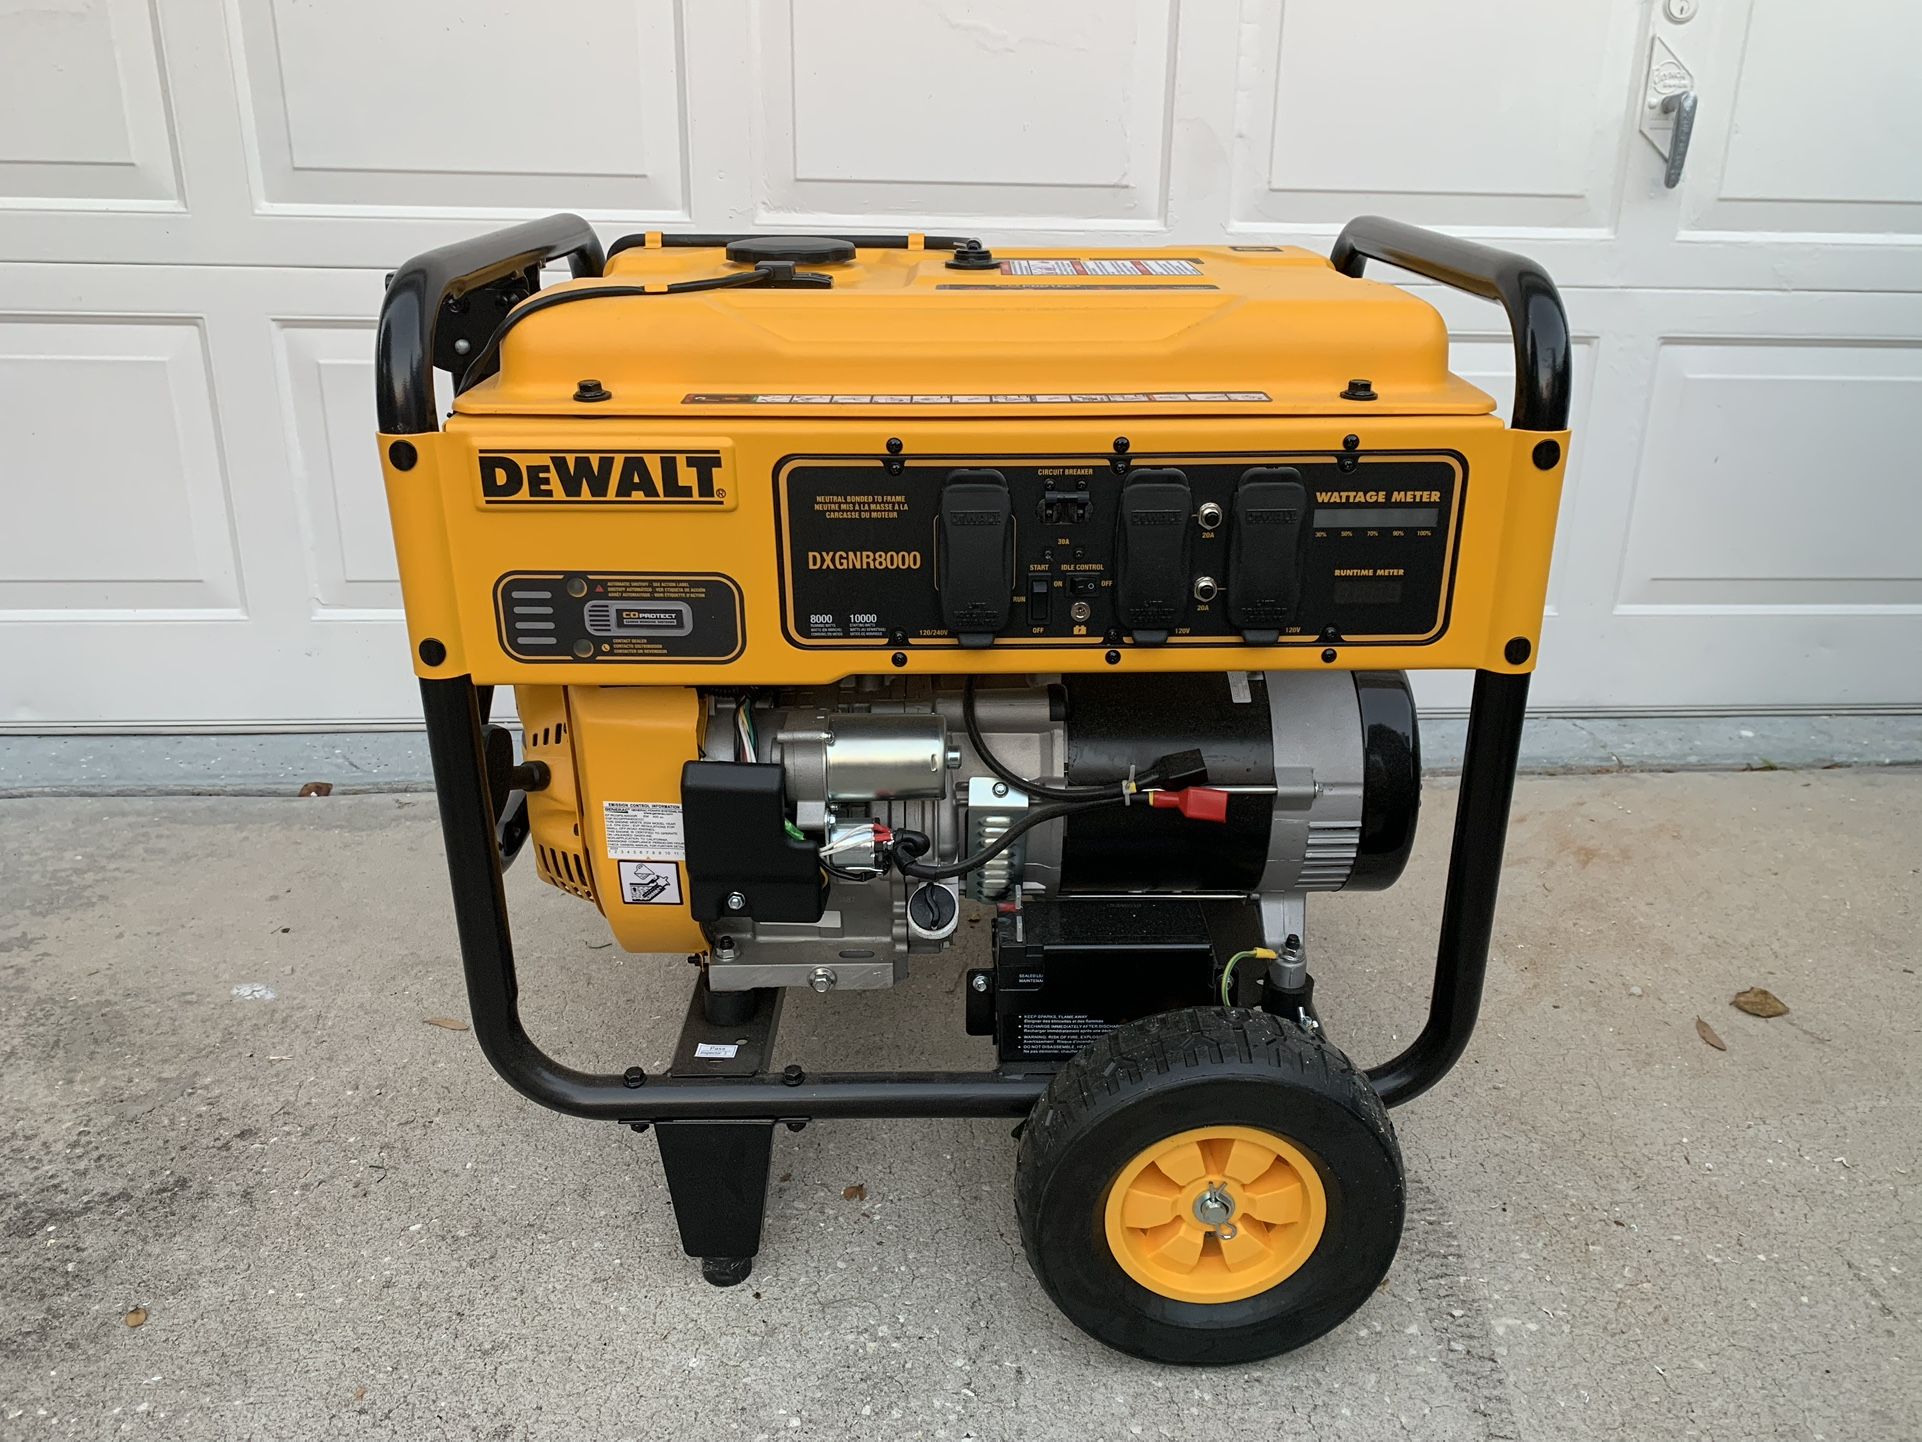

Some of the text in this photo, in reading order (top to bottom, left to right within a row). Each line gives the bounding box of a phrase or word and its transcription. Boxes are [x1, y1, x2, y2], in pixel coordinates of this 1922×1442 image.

[1038, 468, 1094, 476] CIRCUIT BREAKER
[478, 456, 722, 498] DEWALT
[816, 495, 906, 503] NEUTRAL BONDED TO FRAME
[1315, 490, 1441, 503] WATTAGE METER
[814, 503, 840, 511] NEUTRE
[840, 503, 853, 511] MIS
[860, 503, 870, 511] LA
[870, 503, 894, 511] MASSE
[900, 503, 909, 511] LA
[825, 511, 898, 519] CARCASSE DU MOTEUR
[1202, 531, 1215, 539] 20A
[807, 550, 921, 570] DXGNR8000
[1334, 569, 1374, 577] RUNTIME
[622, 611, 639, 619] CO
[809, 614, 833, 624] 8000
[849, 613, 878, 623] 10000
[919, 629, 949, 637] 120/240V
[1285, 626, 1301, 634] 120V
